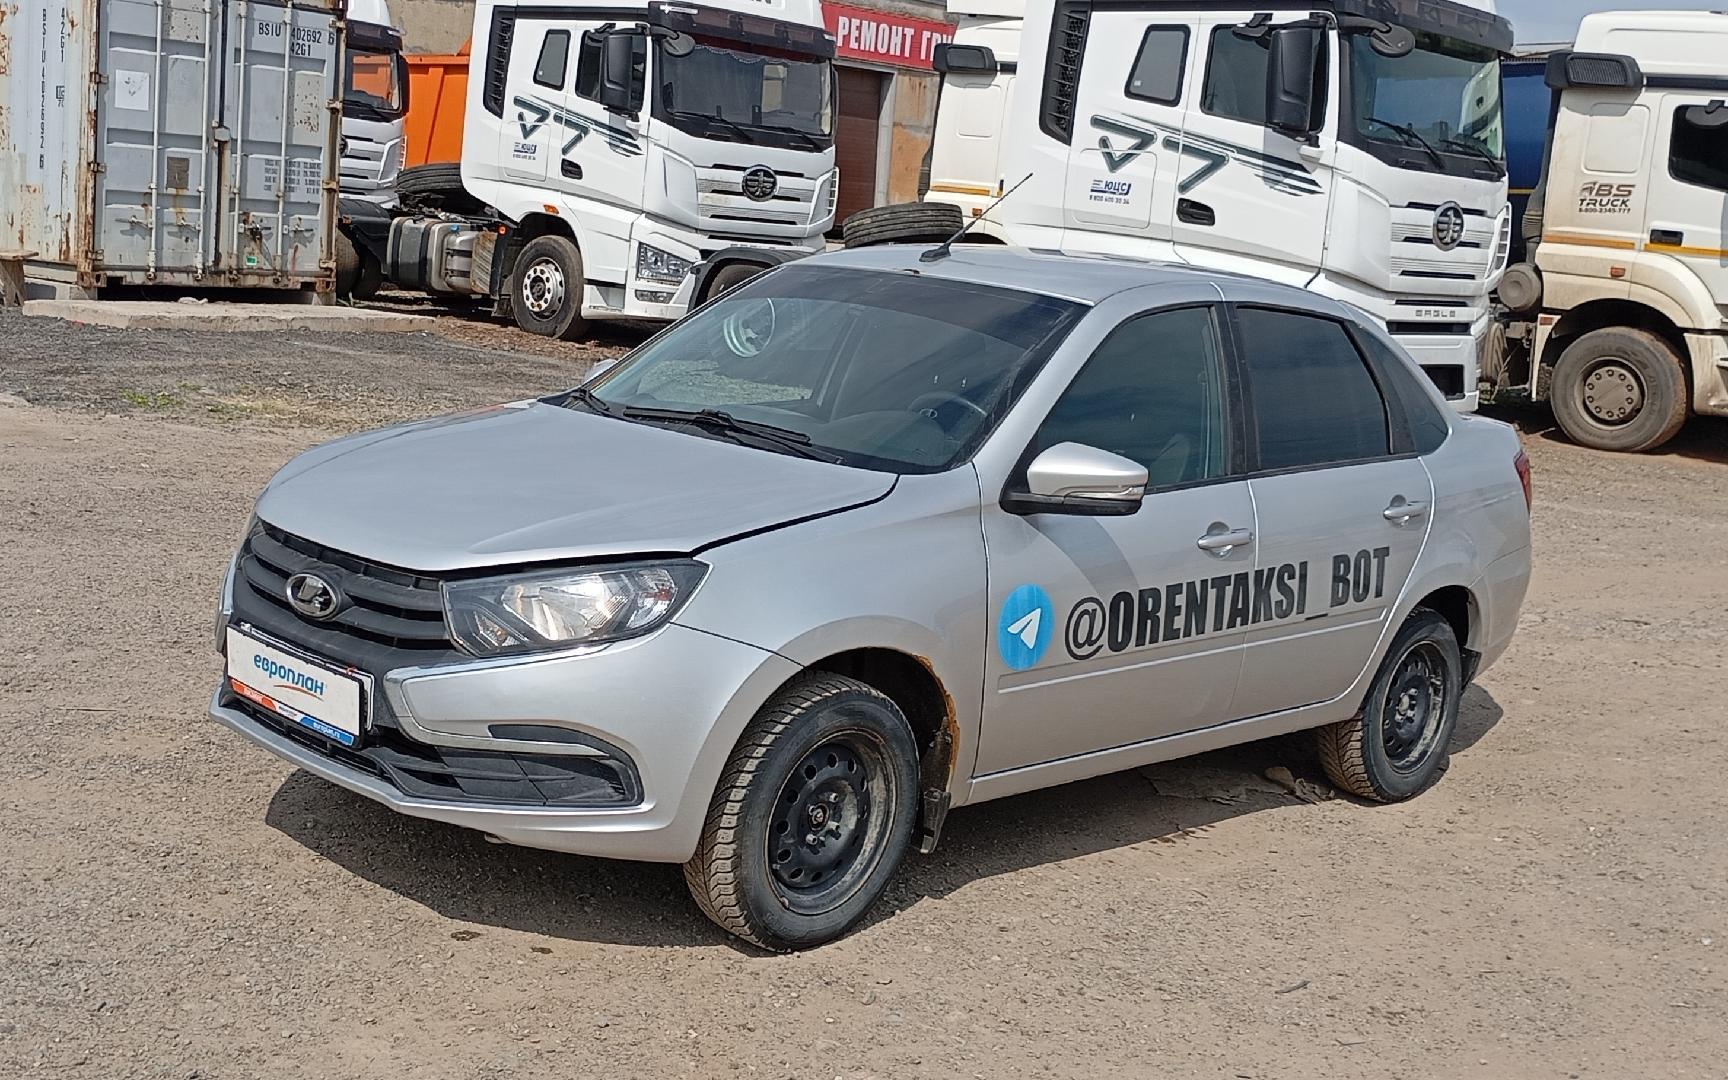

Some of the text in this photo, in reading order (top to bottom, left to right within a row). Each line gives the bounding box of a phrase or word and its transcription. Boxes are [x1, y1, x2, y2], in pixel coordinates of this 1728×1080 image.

[258, 22, 282, 37] BSIU
[291, 27, 322, 44] 402692
[290, 42, 311, 56] 42G1
[837, 15, 915, 58] РЕМОНТ
[1579, 198, 1630, 207] TRUCK
[1064, 546, 1390, 661] @ORENTAKSI_BOT
[253, 654, 325, 696] европлан
